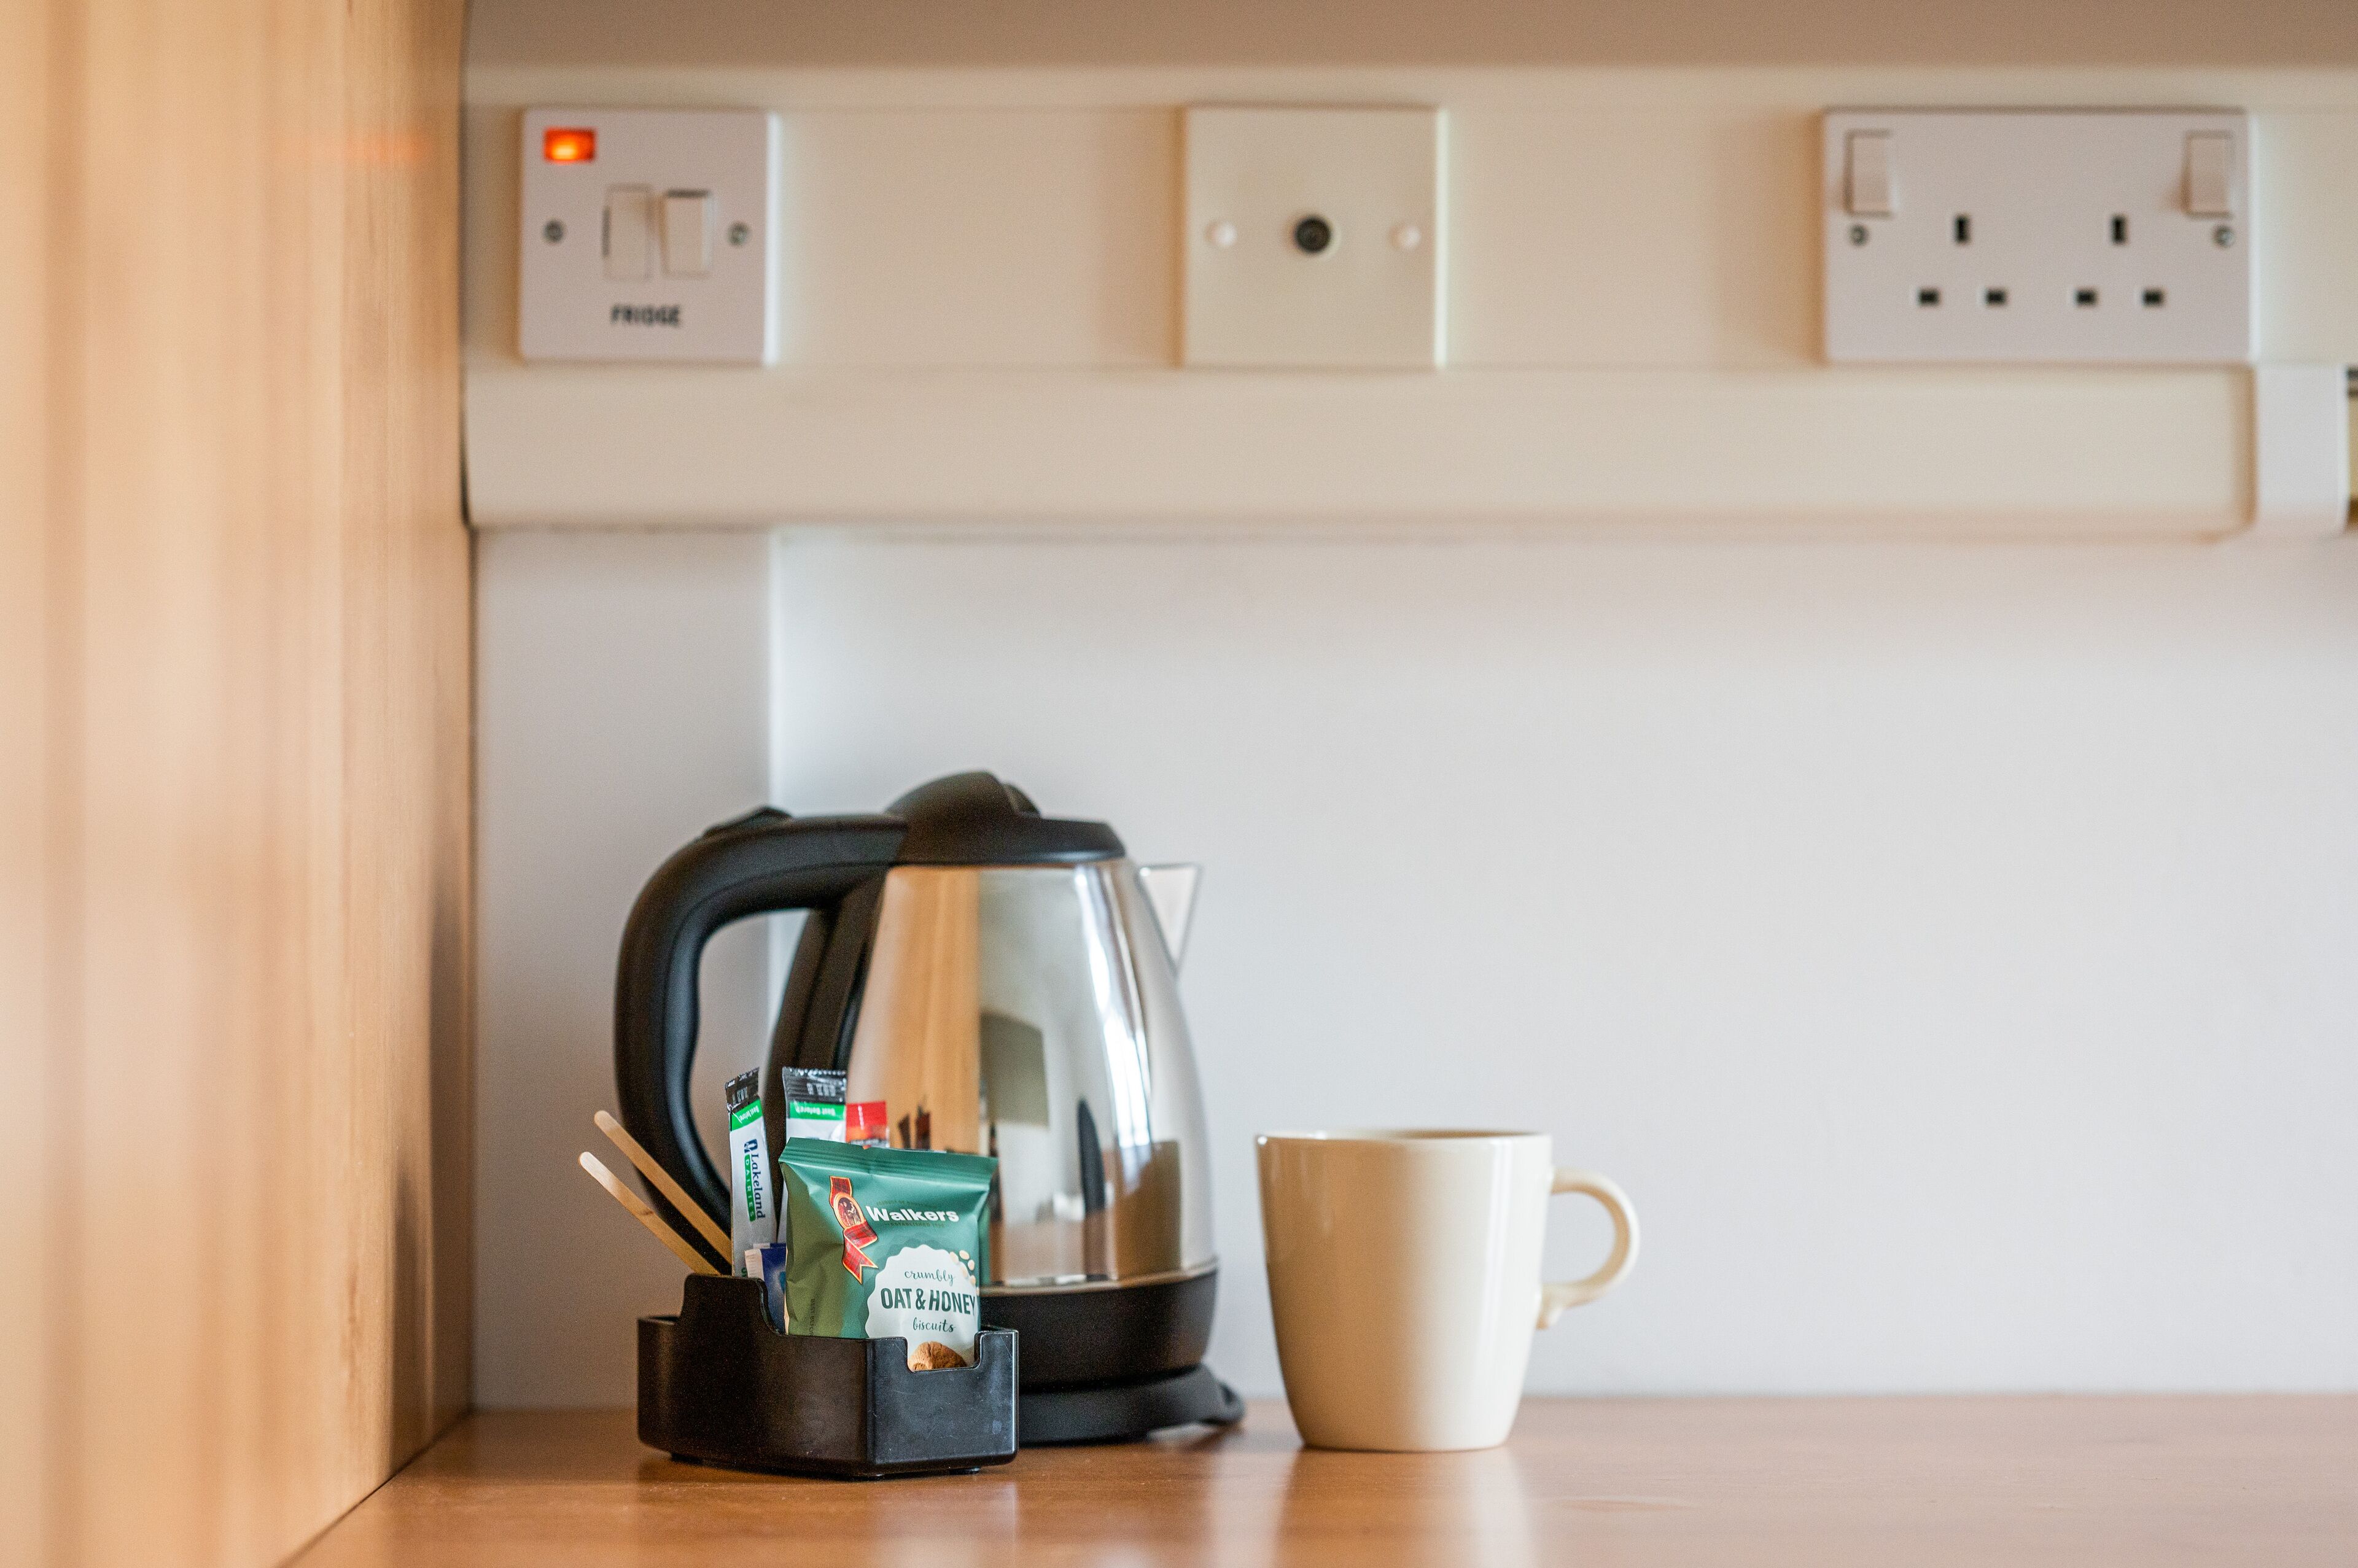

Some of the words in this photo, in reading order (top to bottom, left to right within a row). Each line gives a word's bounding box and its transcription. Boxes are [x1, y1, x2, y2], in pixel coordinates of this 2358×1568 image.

[611, 305, 680, 327] FRIDGE
[745, 1159, 755, 1217] DAIRIES
[751, 1154, 766, 1220] Lakeland
[865, 1206, 960, 1222] Walkers
[904, 1269, 955, 1287] crumbly
[881, 1287, 912, 1310] OAT
[915, 1288, 926, 1311] &
[928, 1289, 975, 1317] HONEY
[912, 1317, 955, 1333] biscuits
